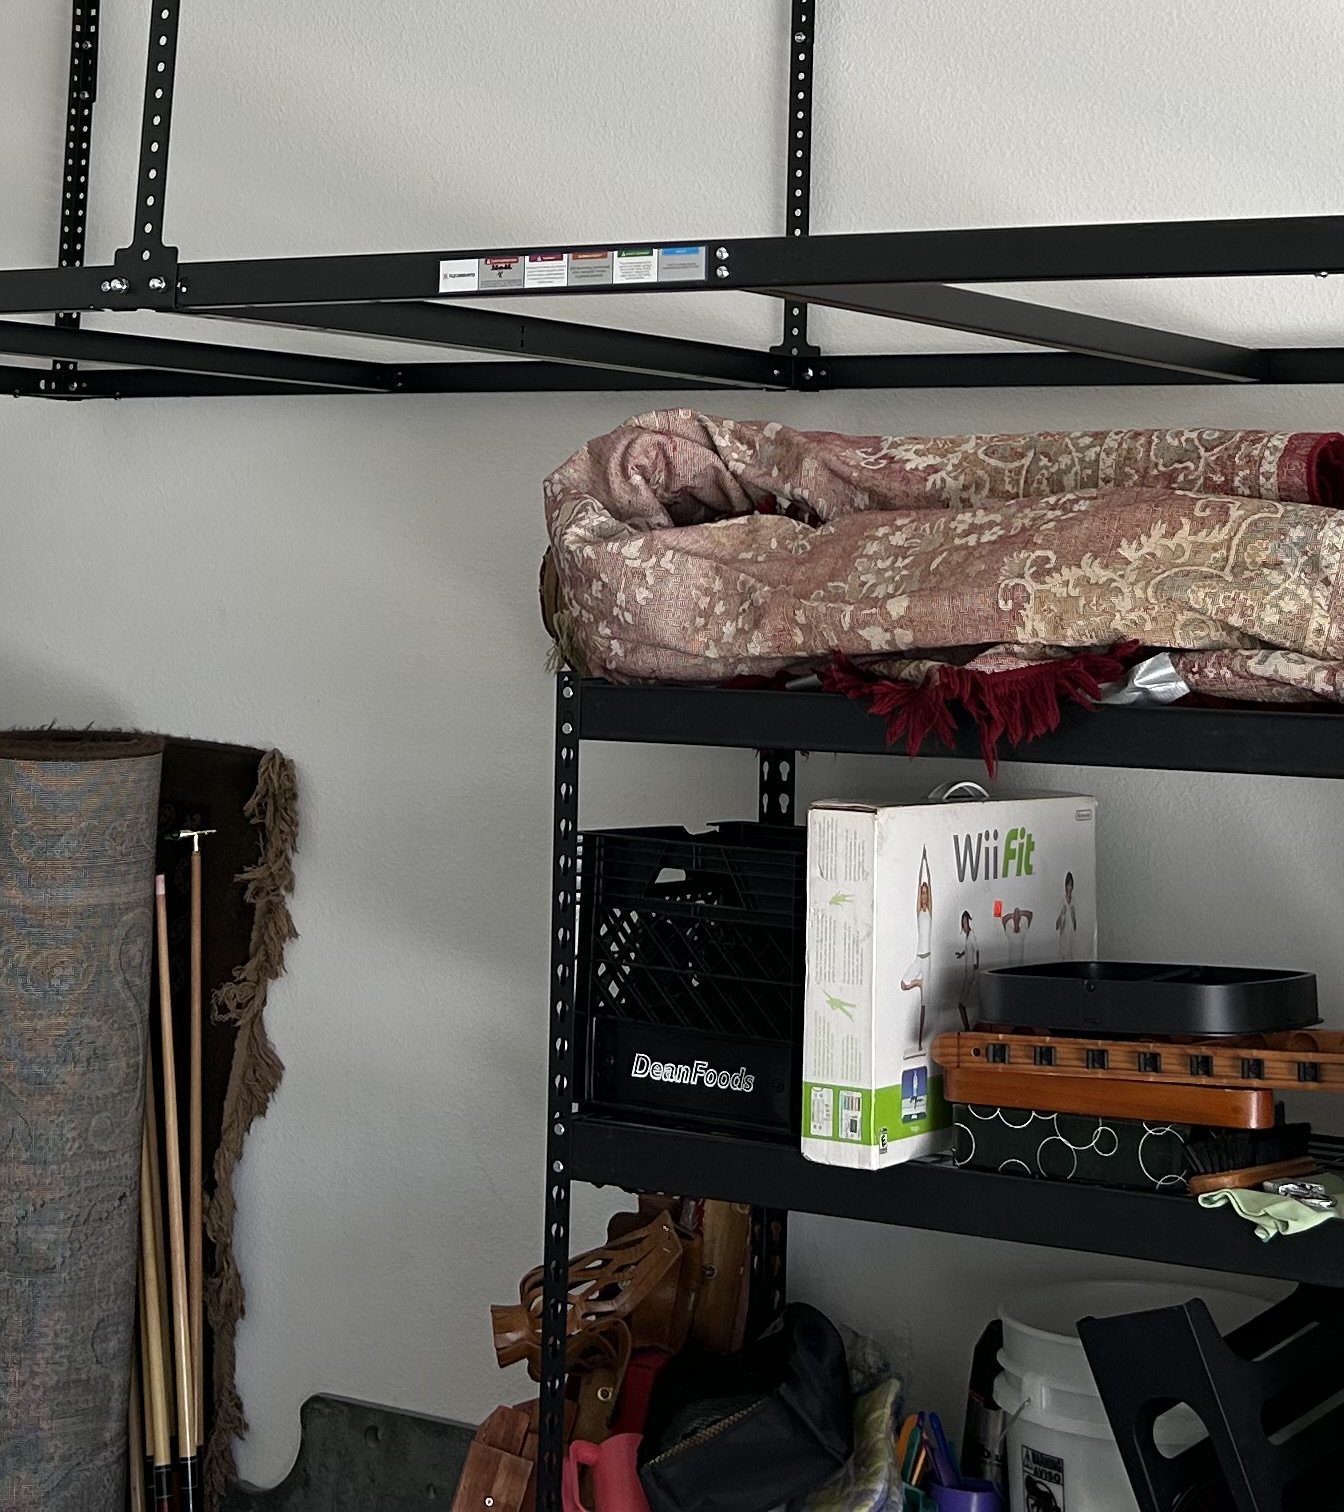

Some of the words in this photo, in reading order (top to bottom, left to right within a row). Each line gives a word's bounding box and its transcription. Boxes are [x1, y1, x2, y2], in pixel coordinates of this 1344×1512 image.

[953, 829, 999, 883] Wii
[1002, 827, 1036, 879] Fit
[631, 1052, 756, 1093] DeanFoods
[1034, 1467, 1061, 1484] AVISO
